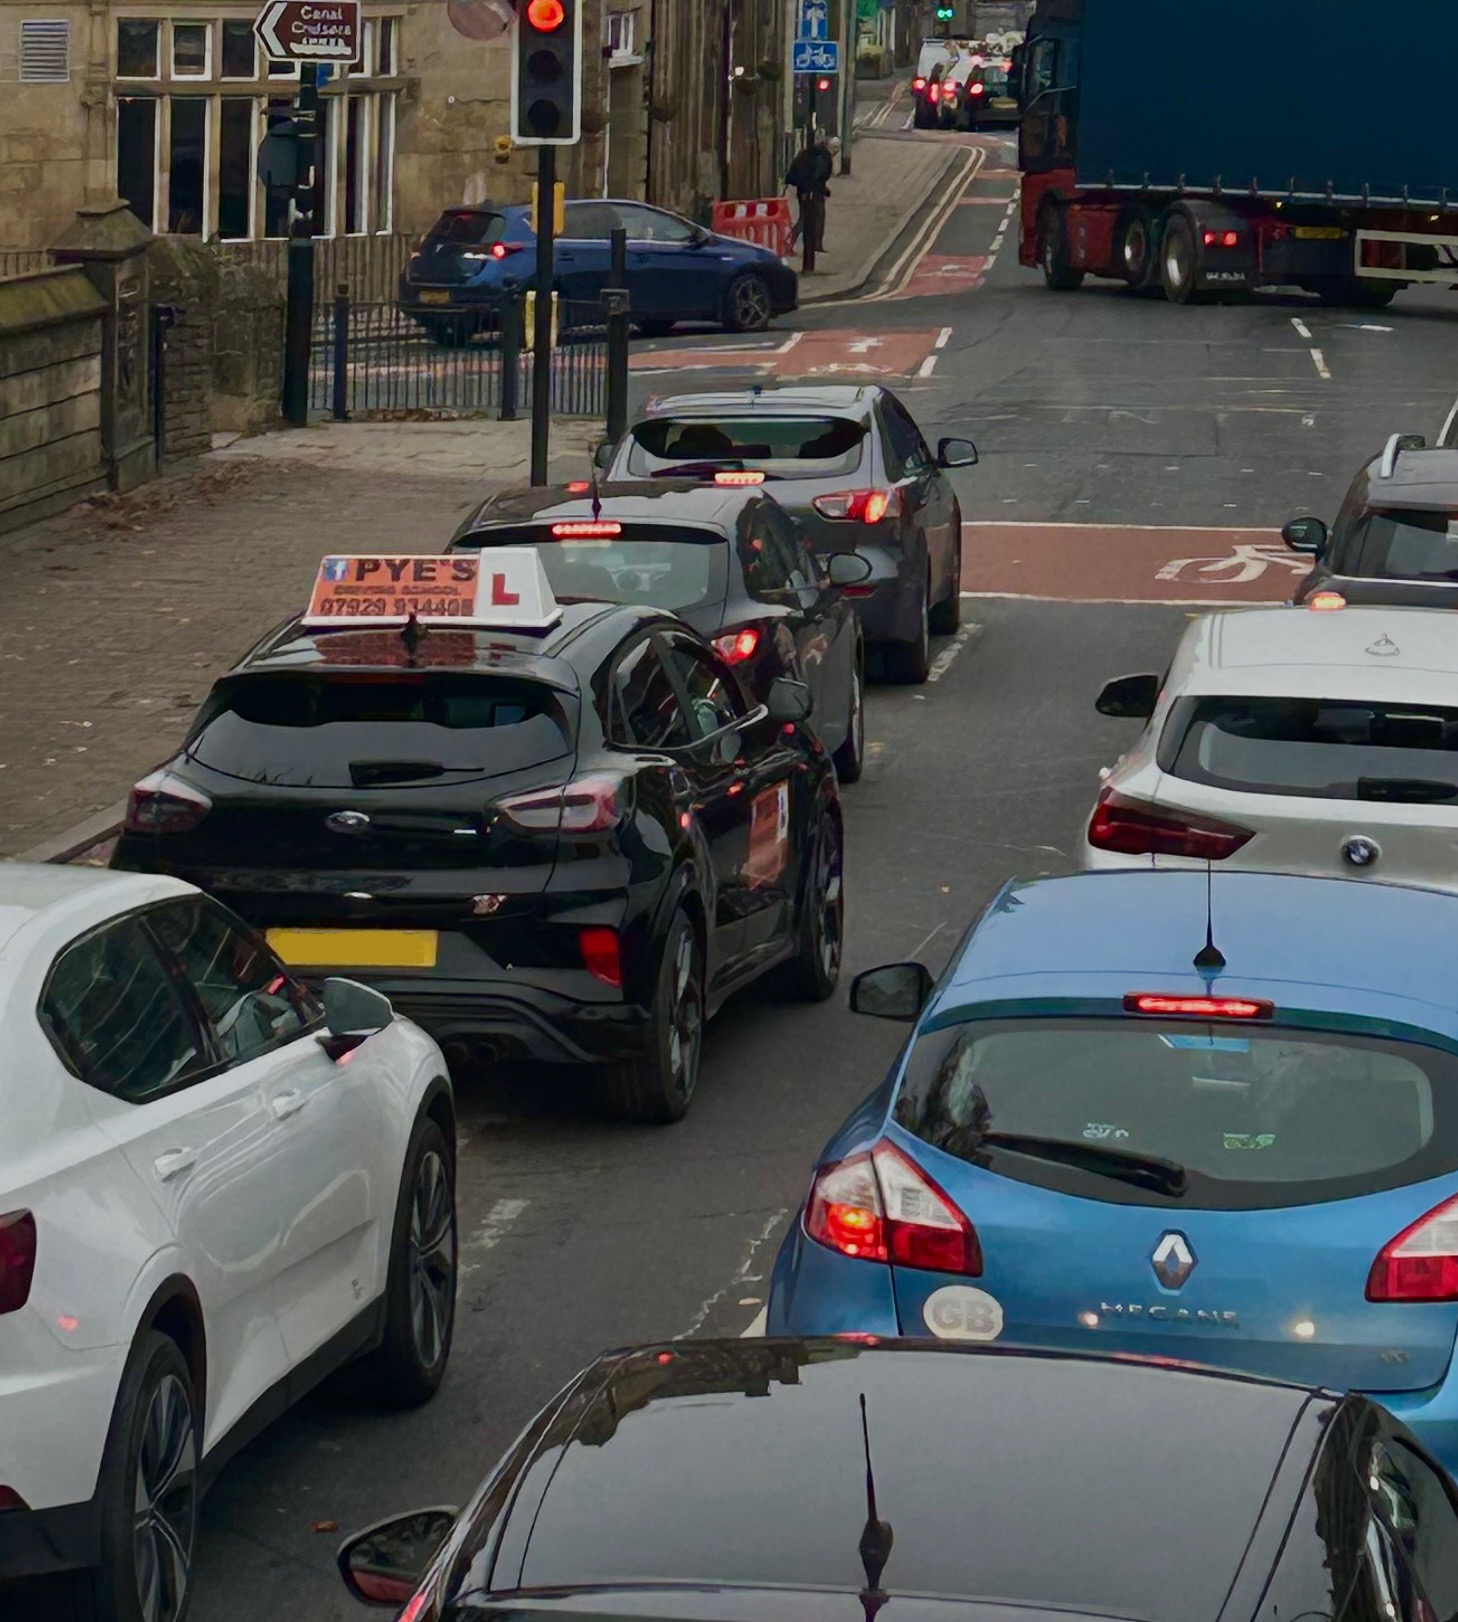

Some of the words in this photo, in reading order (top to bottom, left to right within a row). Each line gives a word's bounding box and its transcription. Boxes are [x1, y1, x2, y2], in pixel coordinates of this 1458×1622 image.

[300, 5, 343, 20] Canal
[355, 558, 478, 582] PYE'S
[492, 573, 520, 606] L
[932, 1300, 995, 1333] GB
